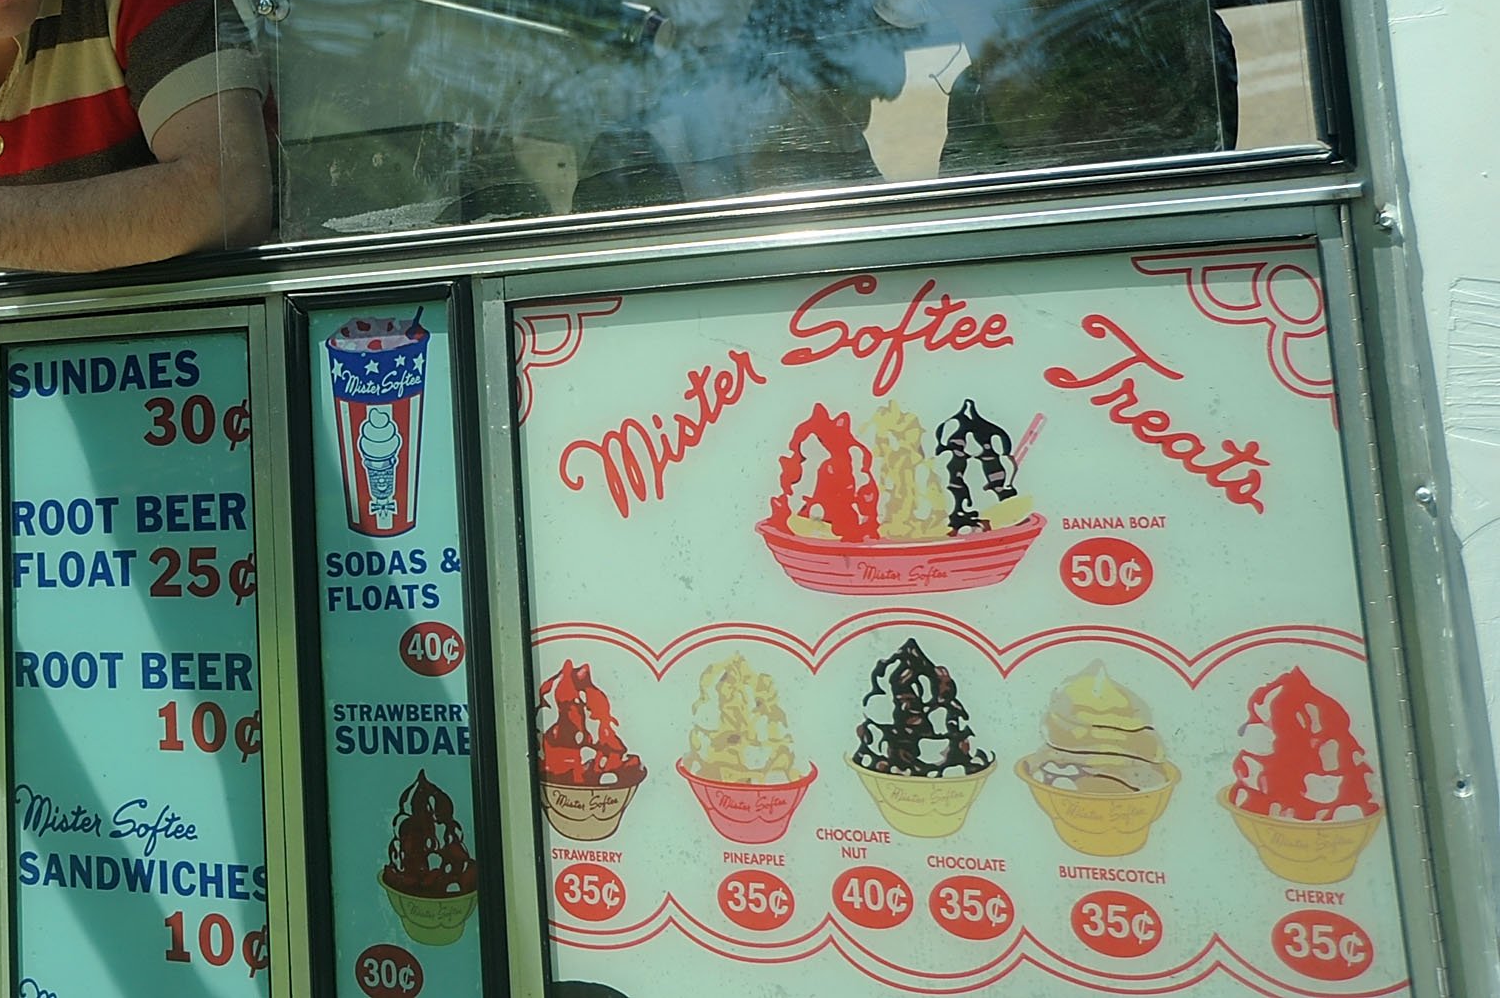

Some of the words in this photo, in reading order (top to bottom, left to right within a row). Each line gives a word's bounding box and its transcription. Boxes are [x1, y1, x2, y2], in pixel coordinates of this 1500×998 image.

[8, 350, 201, 398] SUNDAES
[342, 369, 380, 396] Mister
[381, 369, 422, 398] Softee
[559, 349, 767, 518] Mister
[781, 274, 1013, 396] Softee
[1043, 314, 1271, 515] Treats
[143, 394, 250, 451] 30¢
[11, 497, 119, 536] ROOT
[136, 493, 247, 533] BEER
[1062, 517, 1125, 530] BANANA
[1129, 516, 1167, 529] BOAT
[12, 550, 137, 588] FLOAT
[149, 547, 257, 606] 25¢
[326, 548, 427, 577] SODAS
[440, 547, 461, 574] &
[1070, 554, 1142, 591] 50¢
[327, 584, 440, 611] FLOATS
[406, 633, 460, 665] 40¢
[15, 652, 123, 688] ROOT
[141, 652, 253, 691] BEER
[158, 701, 261, 763] 10¢
[335, 725, 470, 755] SUNDAE
[14, 784, 102, 837] Mister
[109, 799, 198, 856] Softee
[816, 828, 891, 843] CHOCOLATE
[552, 848, 622, 863] STRAWBERRY
[723, 852, 785, 866] PINEAPPLE
[841, 847, 867, 859] NUT
[927, 855, 1006, 872] CHOCOLATE
[563, 873, 620, 909] 35¢
[1059, 865, 1166, 884] BUTTERSCOTCH
[727, 881, 789, 918] 35¢
[842, 878, 907, 916] 40¢
[939, 887, 1007, 927] 35¢
[1285, 889, 1345, 905] CHERRY
[1082, 902, 1156, 944] 35¢
[165, 911, 268, 978] 10¢
[1283, 922, 1365, 967] 35¢
[363, 958, 416, 994] 30¢
